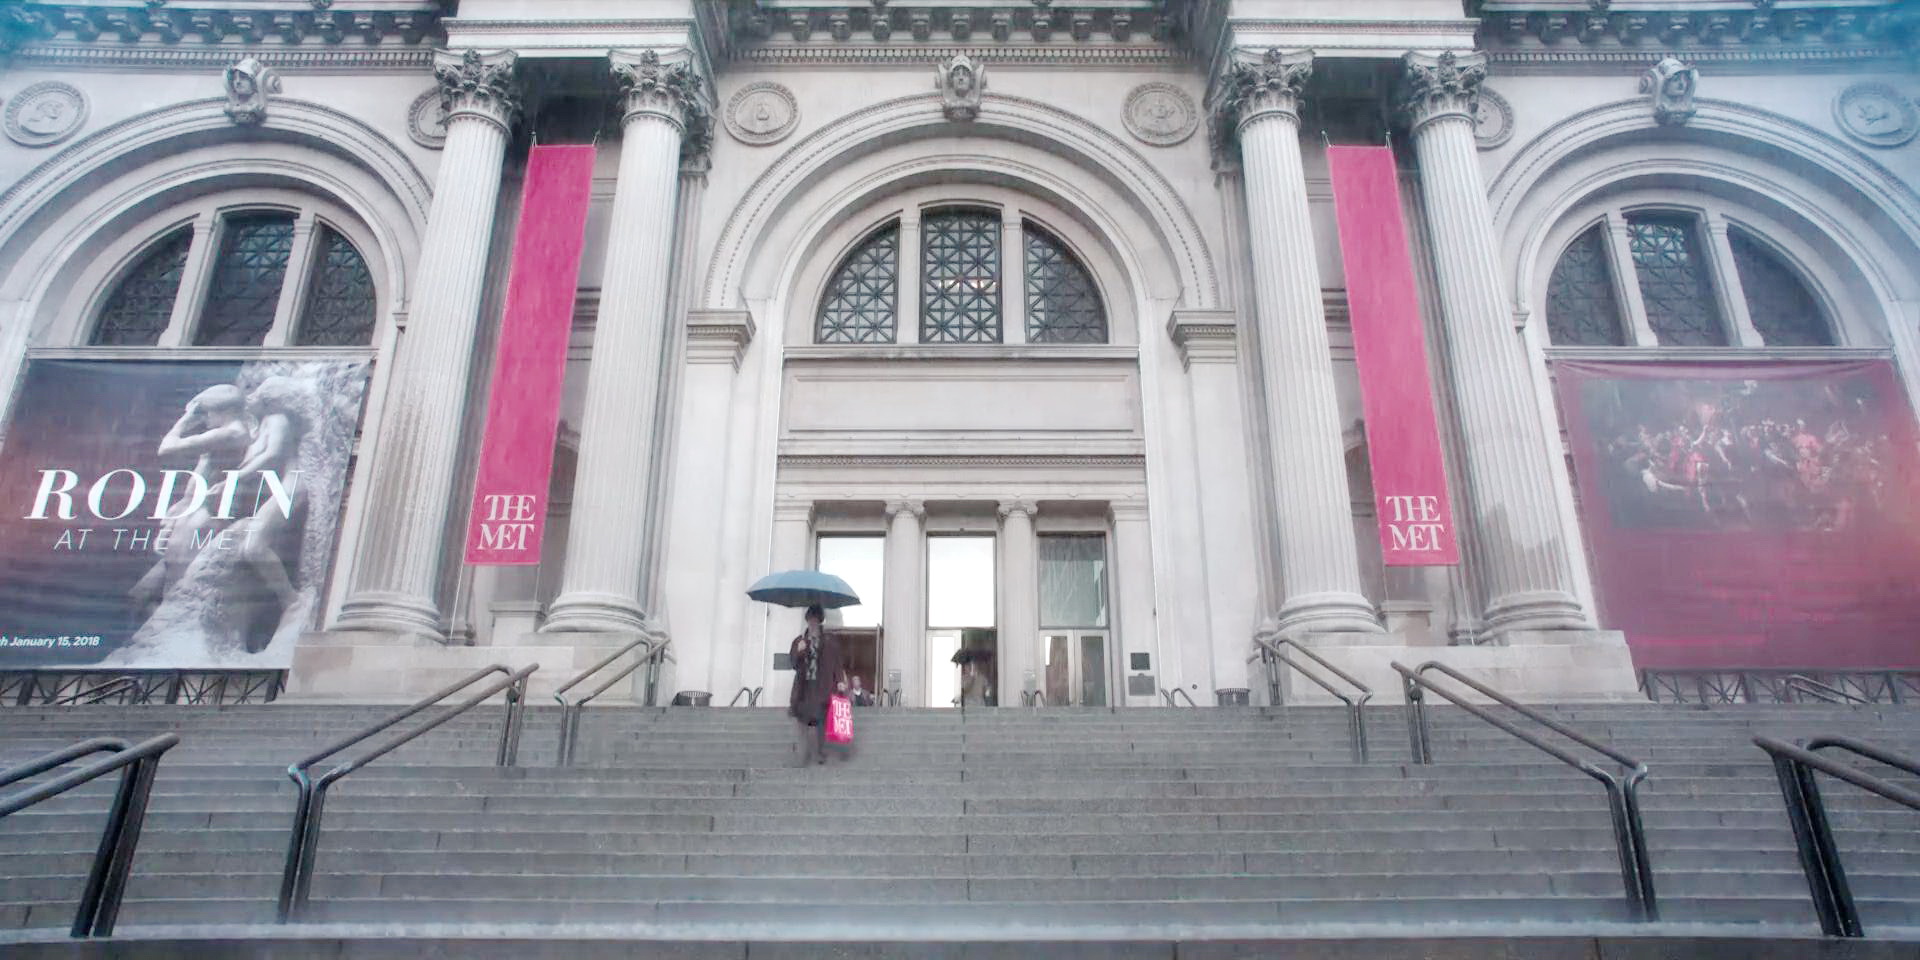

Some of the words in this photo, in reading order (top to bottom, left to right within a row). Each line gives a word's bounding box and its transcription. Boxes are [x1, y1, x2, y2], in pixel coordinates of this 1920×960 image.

[23, 469, 305, 520] RODIN
[483, 494, 536, 521] THE
[1385, 495, 1440, 521] THE
[54, 528, 93, 550] AT
[112, 528, 172, 550] THE
[190, 528, 257, 550] MET
[476, 523, 535, 550] MET
[1388, 524, 1444, 551] MET
[9, 636, 56, 648] January
[58, 636, 71, 647] 15,
[73, 636, 100, 646] 2018
